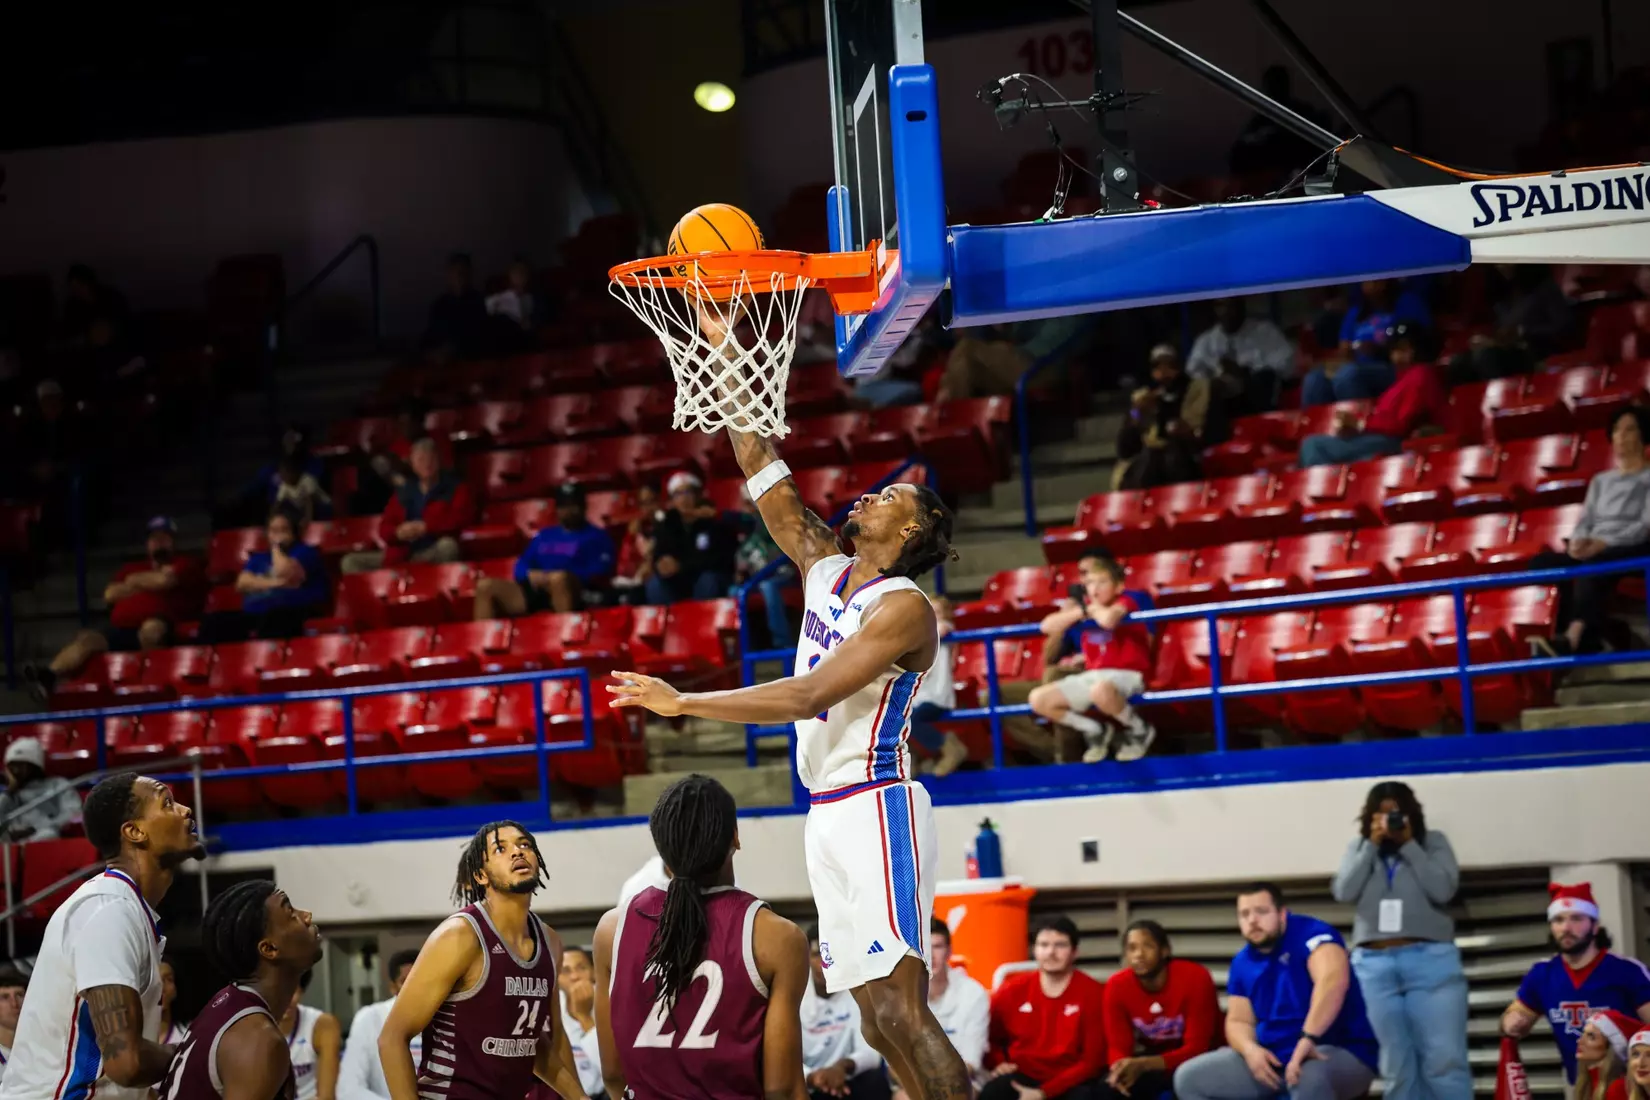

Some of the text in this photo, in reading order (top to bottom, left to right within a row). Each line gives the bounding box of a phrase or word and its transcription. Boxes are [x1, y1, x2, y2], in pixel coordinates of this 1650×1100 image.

[1018, 30, 1093, 78] 103
[1471, 174, 1650, 228] SPALDIN
[505, 976, 548, 997] DALLAS
[633, 959, 724, 1049] 22
[511, 1000, 541, 1035] 24
